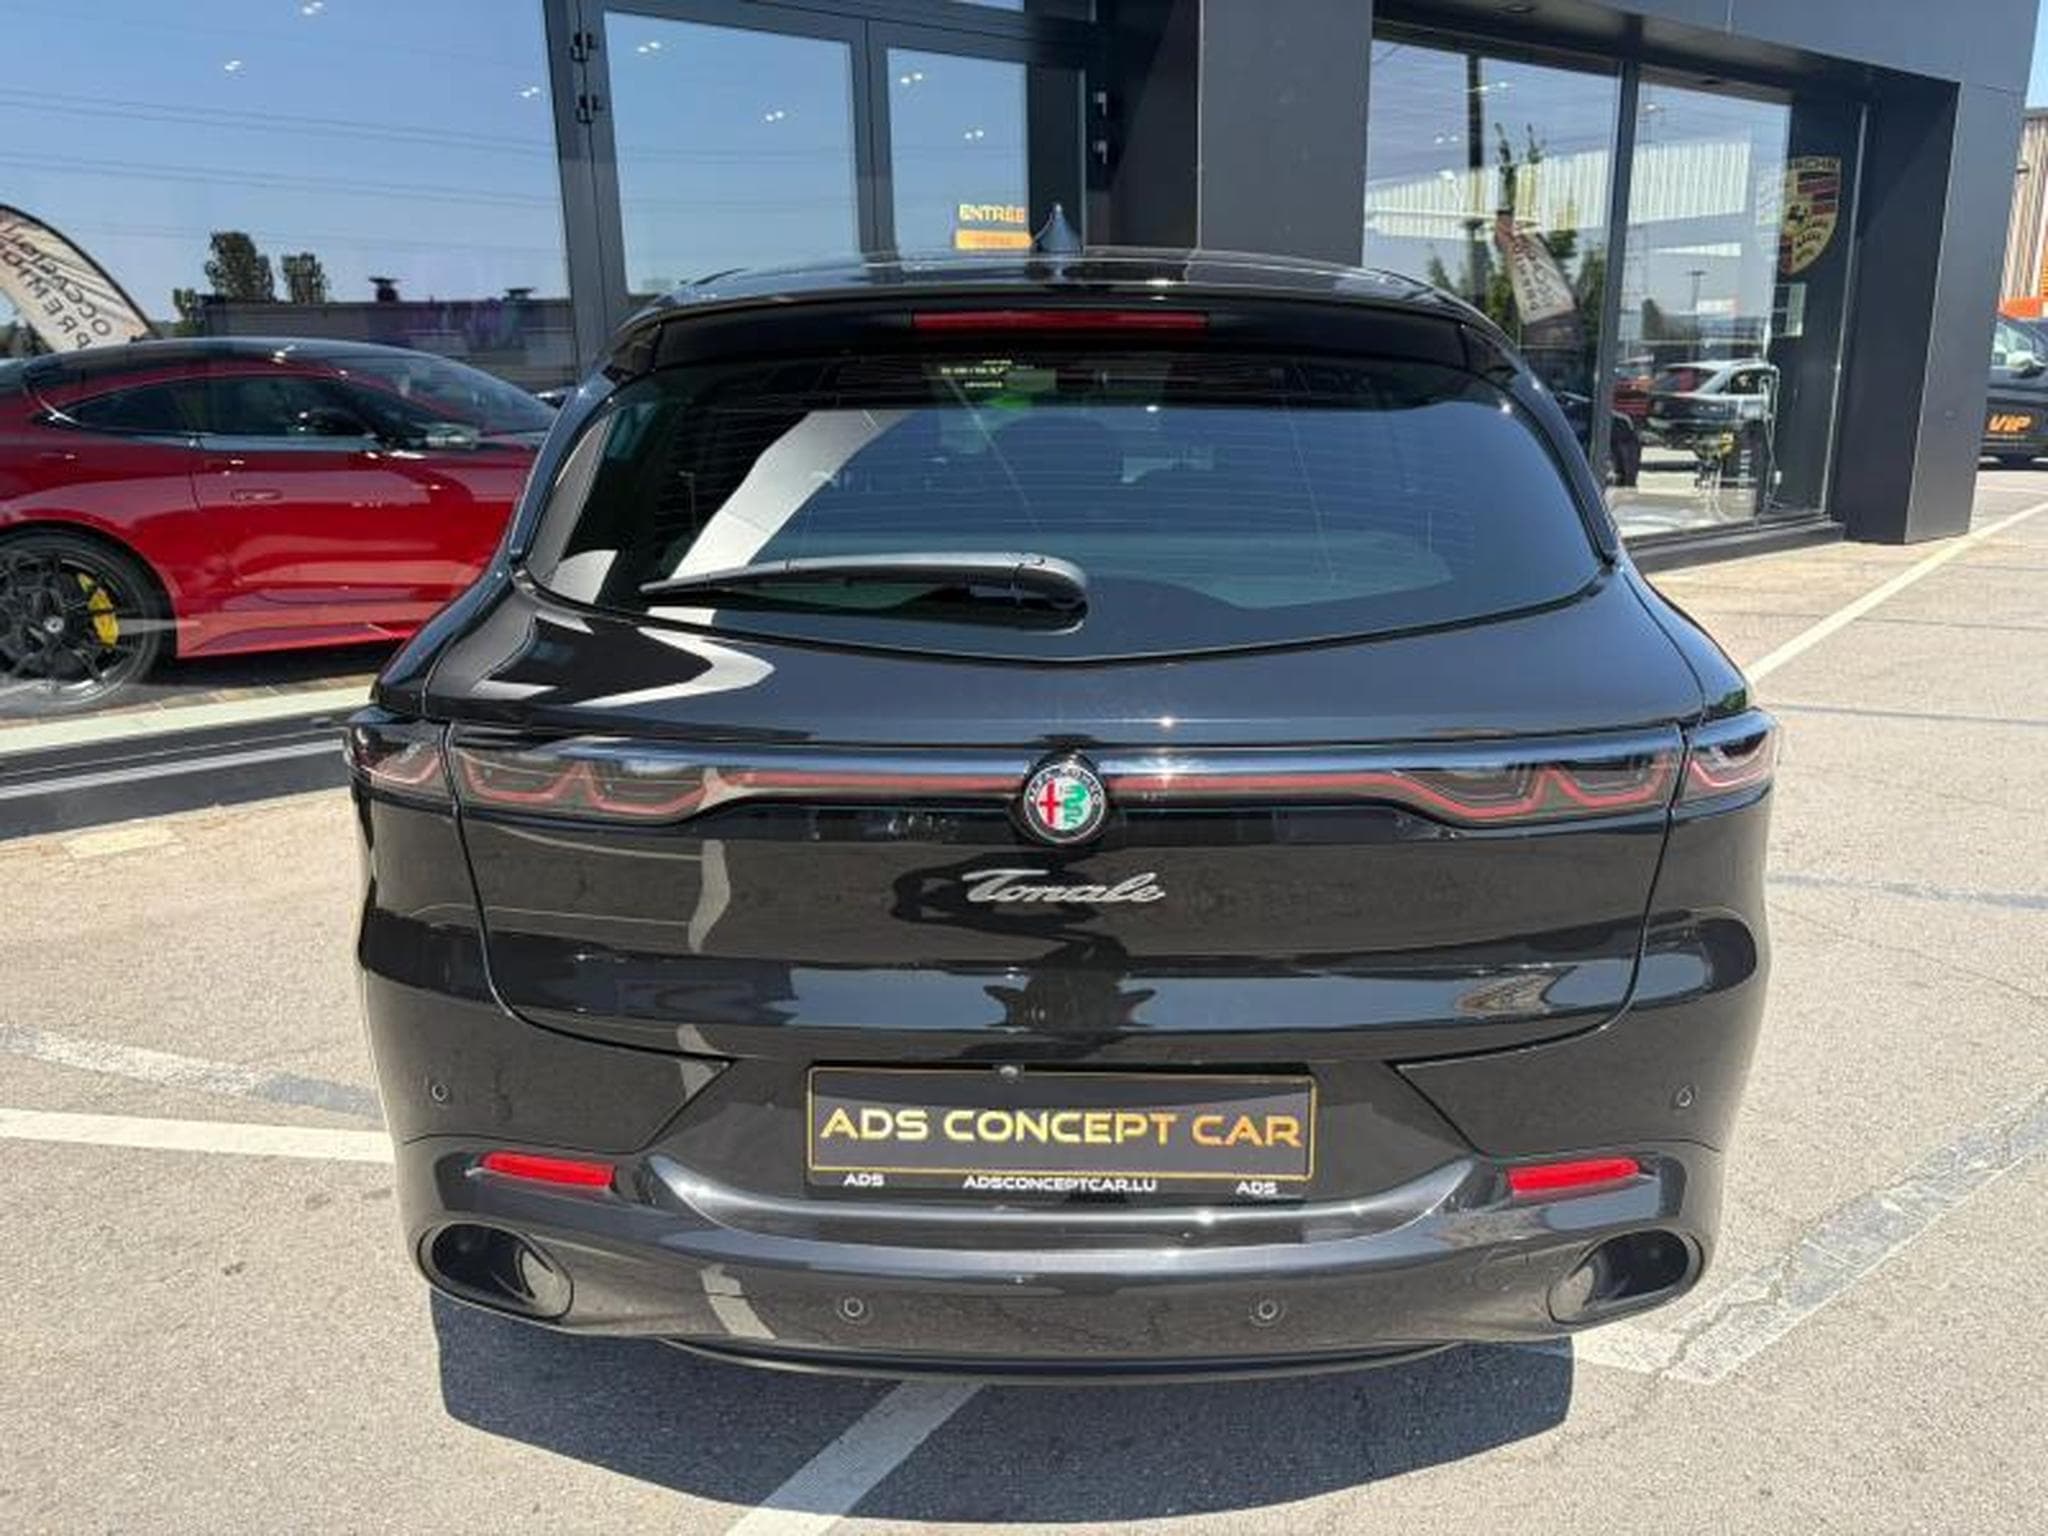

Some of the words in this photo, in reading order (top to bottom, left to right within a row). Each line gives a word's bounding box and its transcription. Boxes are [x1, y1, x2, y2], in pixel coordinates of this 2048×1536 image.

[1989, 414, 2031, 431] VIP
[961, 869, 1166, 903] Tonale
[820, 1107, 928, 1141] ADS
[943, 1108, 1177, 1145] CONCEPT
[1191, 1114, 1302, 1148] CAR
[843, 1172, 885, 1188] ADS
[962, 1174, 1157, 1193] ADSCONCEPTCAR.LU
[1235, 1180, 1278, 1196] ADS
